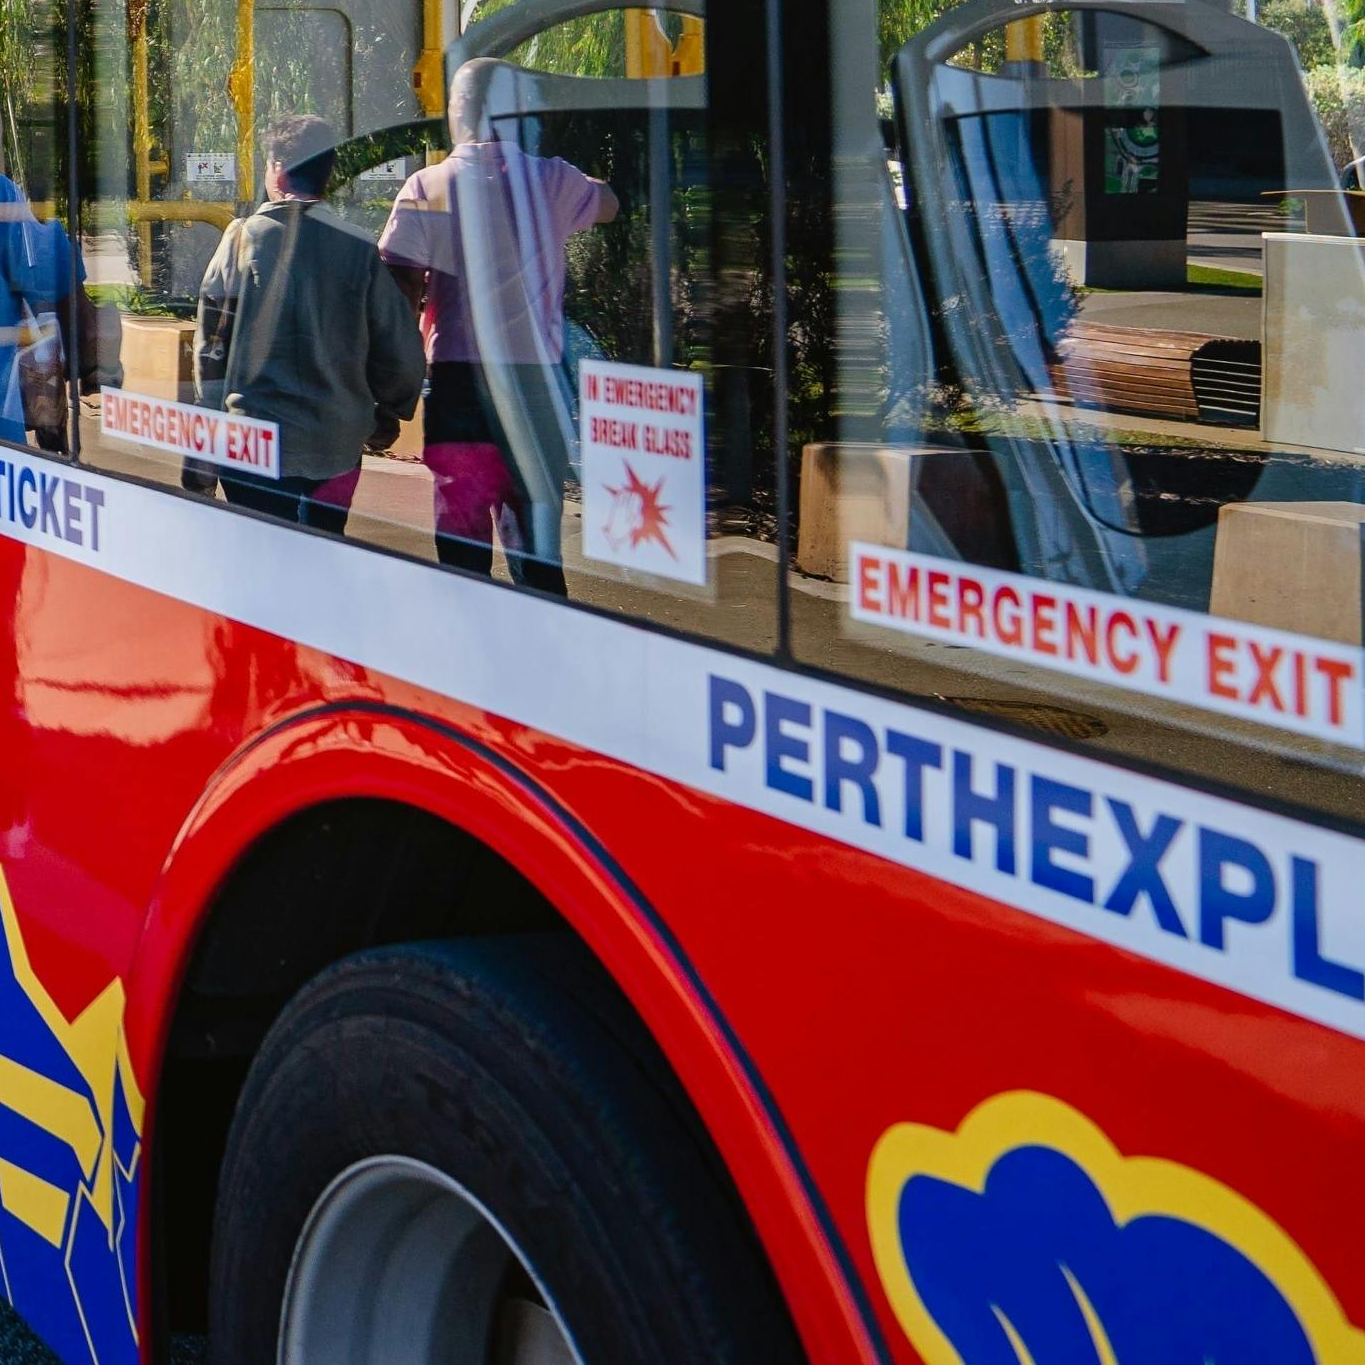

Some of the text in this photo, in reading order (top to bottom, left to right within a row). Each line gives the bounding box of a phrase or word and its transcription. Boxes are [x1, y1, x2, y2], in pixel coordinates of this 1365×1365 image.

[103, 392, 273, 468] EMERGENCY EXIT
[585, 373, 697, 418] IN EMERGENCY
[591, 417, 692, 459] BREAK GLASS
[859, 556, 1355, 727] EMERGENCY EXIT
[709, 674, 1365, 1001] PERTHEXPL
